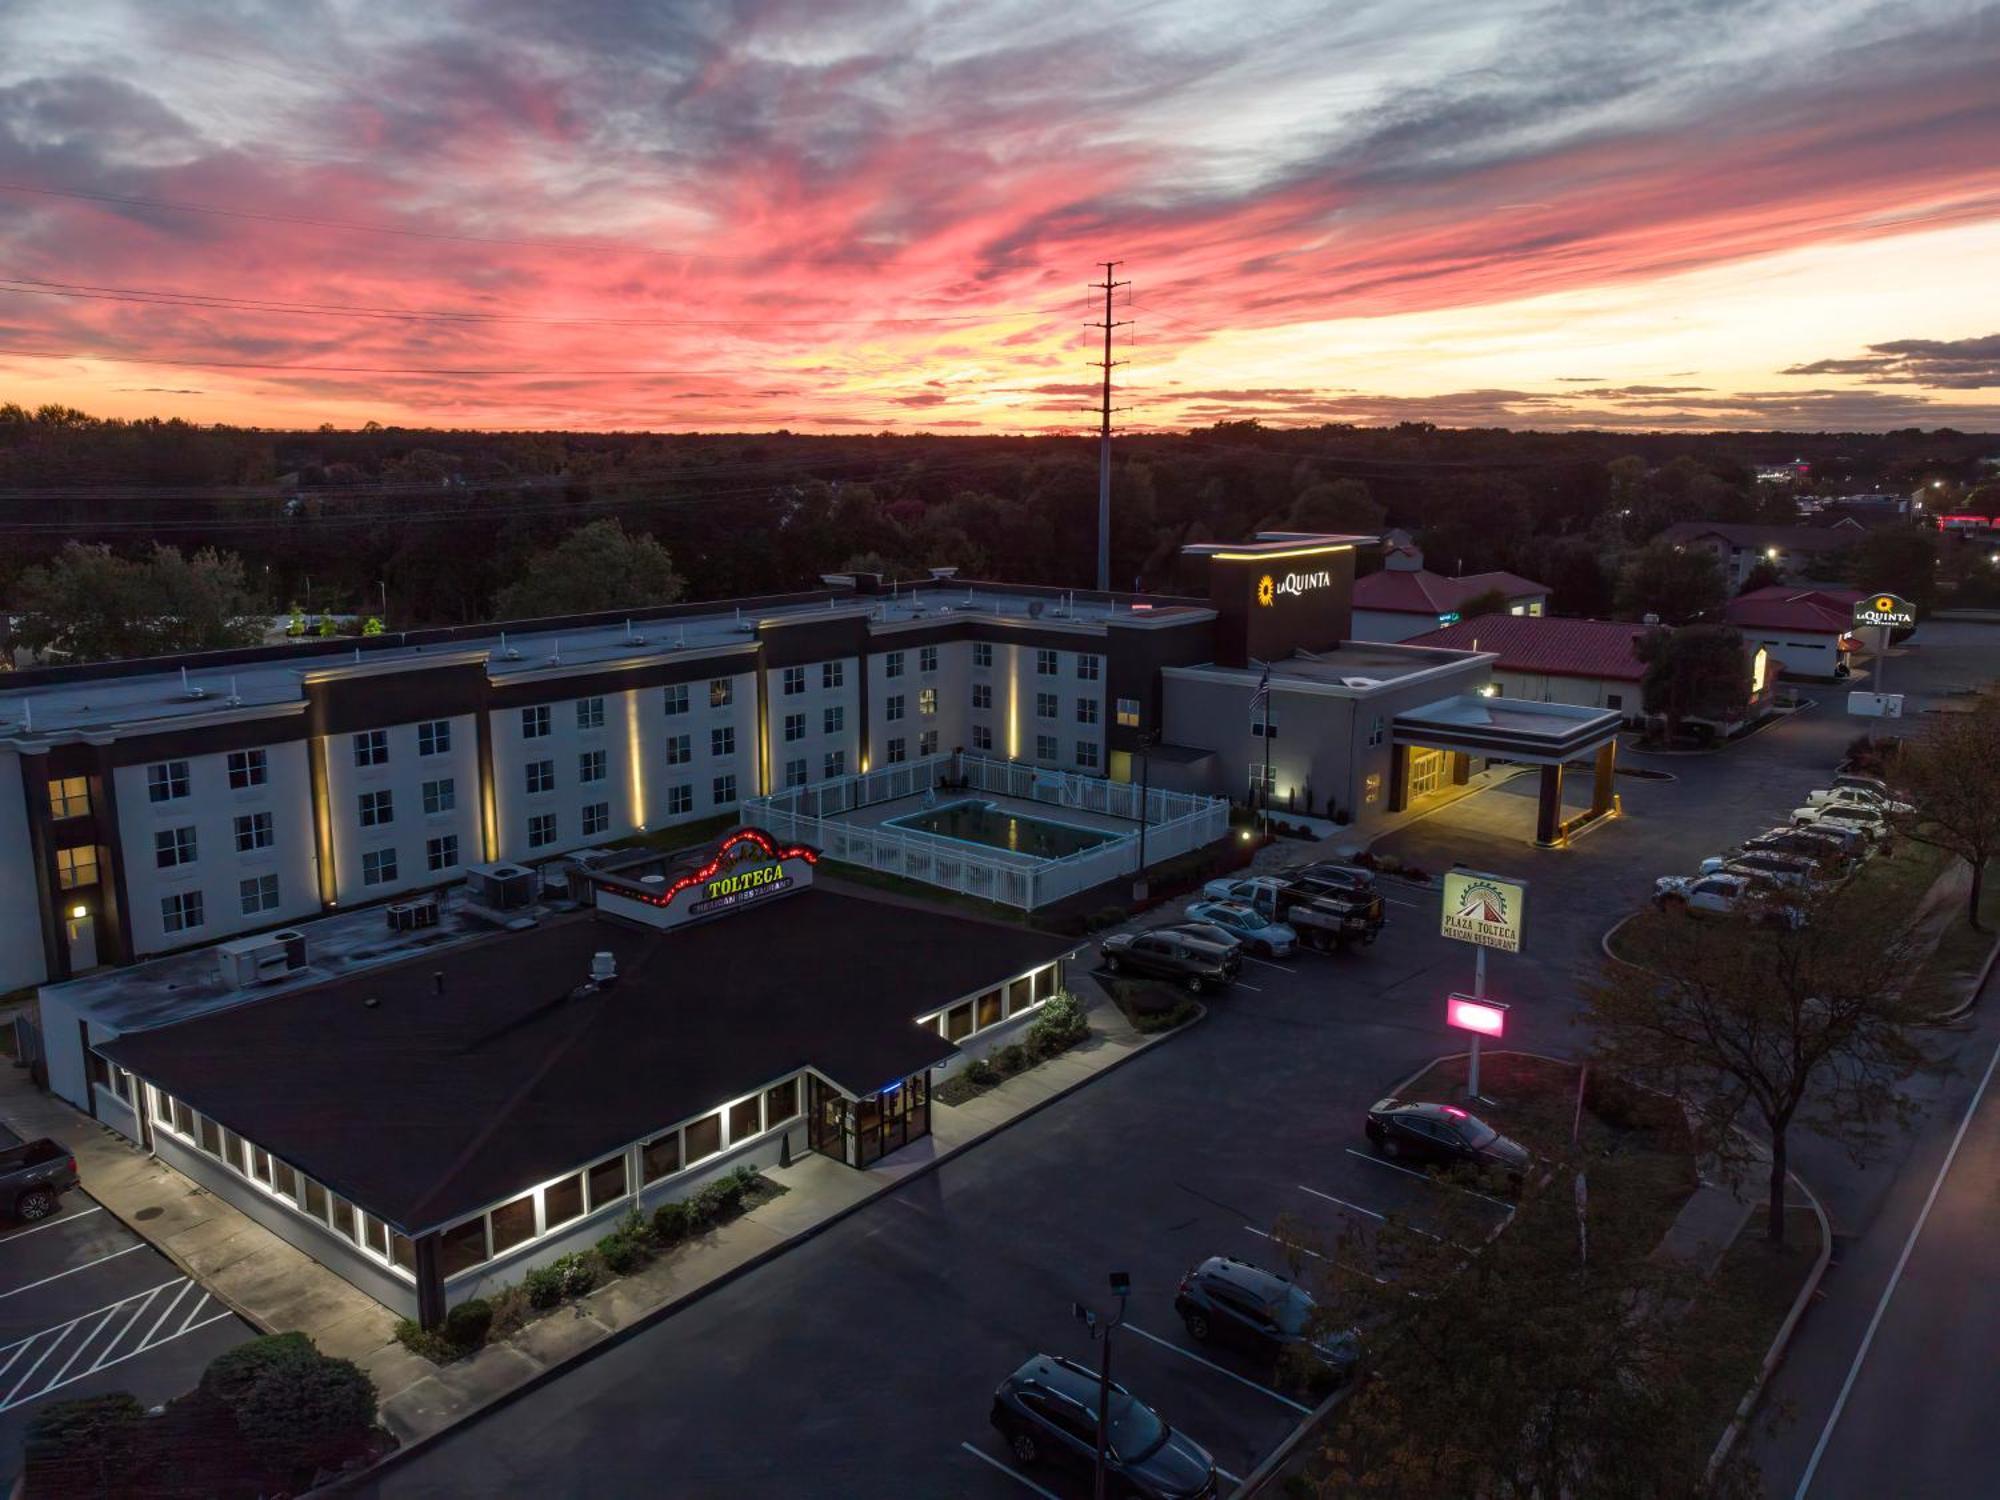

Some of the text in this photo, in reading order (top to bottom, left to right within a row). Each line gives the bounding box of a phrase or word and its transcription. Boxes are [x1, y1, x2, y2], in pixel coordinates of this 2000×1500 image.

[1286, 571, 1330, 596] QUINTA
[1865, 611, 1911, 622] QUINTA
[709, 864, 783, 898] TOLTECA
[1446, 915, 1516, 940] PLAZA TOLTECA
